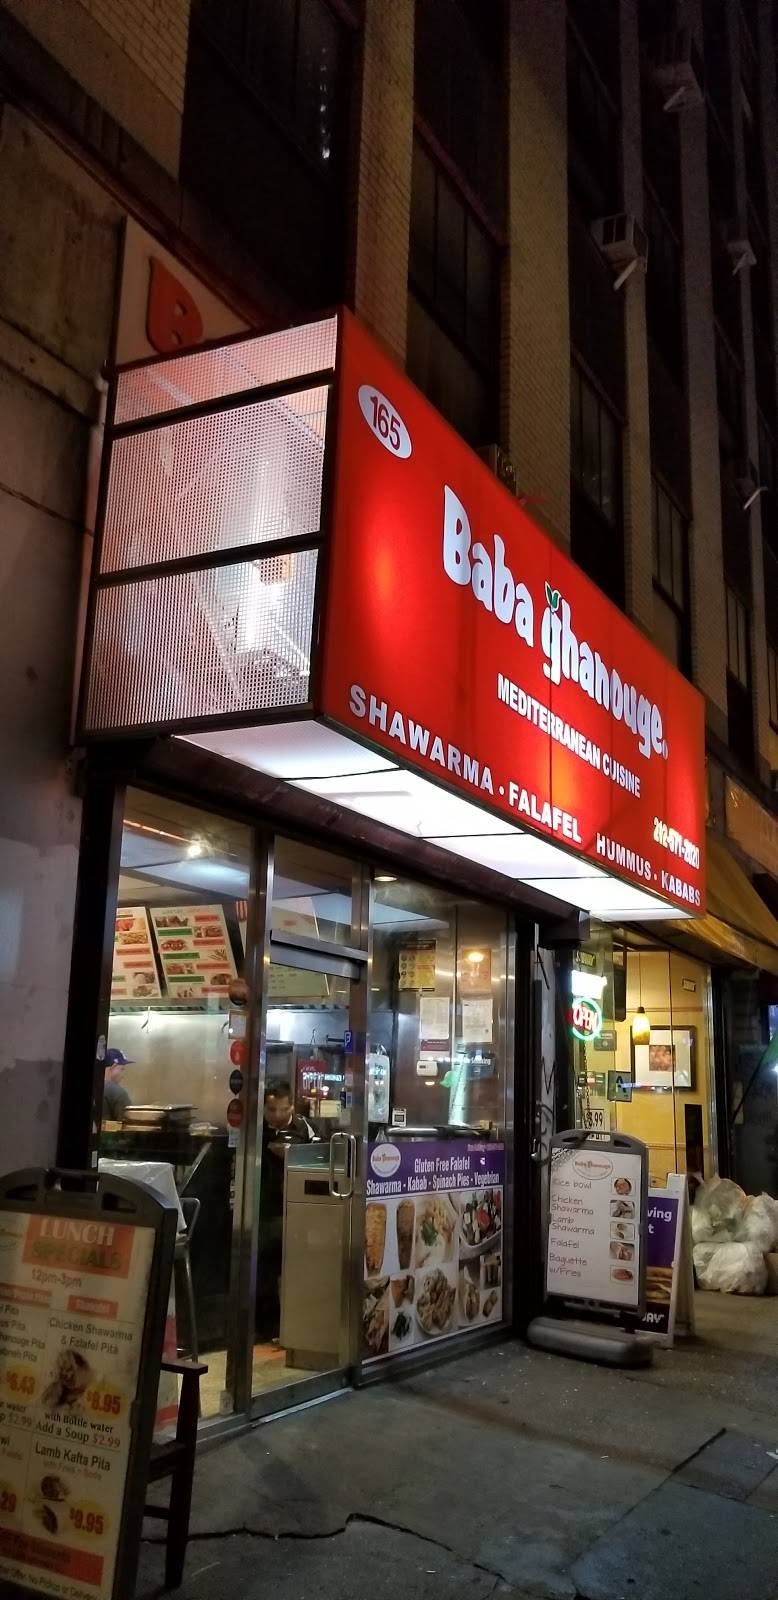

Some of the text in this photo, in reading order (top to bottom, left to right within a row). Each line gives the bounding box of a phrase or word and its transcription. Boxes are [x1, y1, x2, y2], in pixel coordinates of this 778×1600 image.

[370, 395, 401, 451] 165
[442, 484, 535, 648] Baba
[498, 672, 641, 799] MEDITERRANEAN CUISINE
[349, 684, 701, 906] SHAWARMA FALAFEL HUMMUS KABABS
[572, 1003, 598, 1032] OPEN
[414, 1158, 435, 1174] Gluten
[436, 1157, 449, 1172] Free
[450, 1156, 470, 1171] Falafel
[366, 1180, 401, 1196] Shawarma
[407, 1177, 427, 1192] Kabab
[432, 1173, 456, 1191] Spinach
[457, 1172, 470, 1187] Pies
[573, 1181, 592, 1189] bowl
[551, 1203, 594, 1215] Shawarma
[552, 1194, 583, 1204] Chicken
[40, 1218, 115, 1246] LUNCH
[551, 1223, 595, 1235] Shawarma
[551, 1238, 580, 1249] Falafel
[549, 1252, 588, 1266] Baguette
[32, 1268, 82, 1288] 12pm-3pm
[49, 1317, 133, 1341] Chicken Shawarma
[69, 1336, 99, 1351] Falafel
[100, 1342, 119, 1354] Pita
[45, 1412, 61, 1422] with
[90, 1422, 113, 1433] water
[36, 1421, 54, 1433] Add
[65, 1427, 90, 1444] Soup
[94, 1432, 121, 1448] $2.99
[35, 1442, 61, 1459] Lamb
[64, 1449, 88, 1466] Kafta
[91, 1455, 111, 1471] Pita
